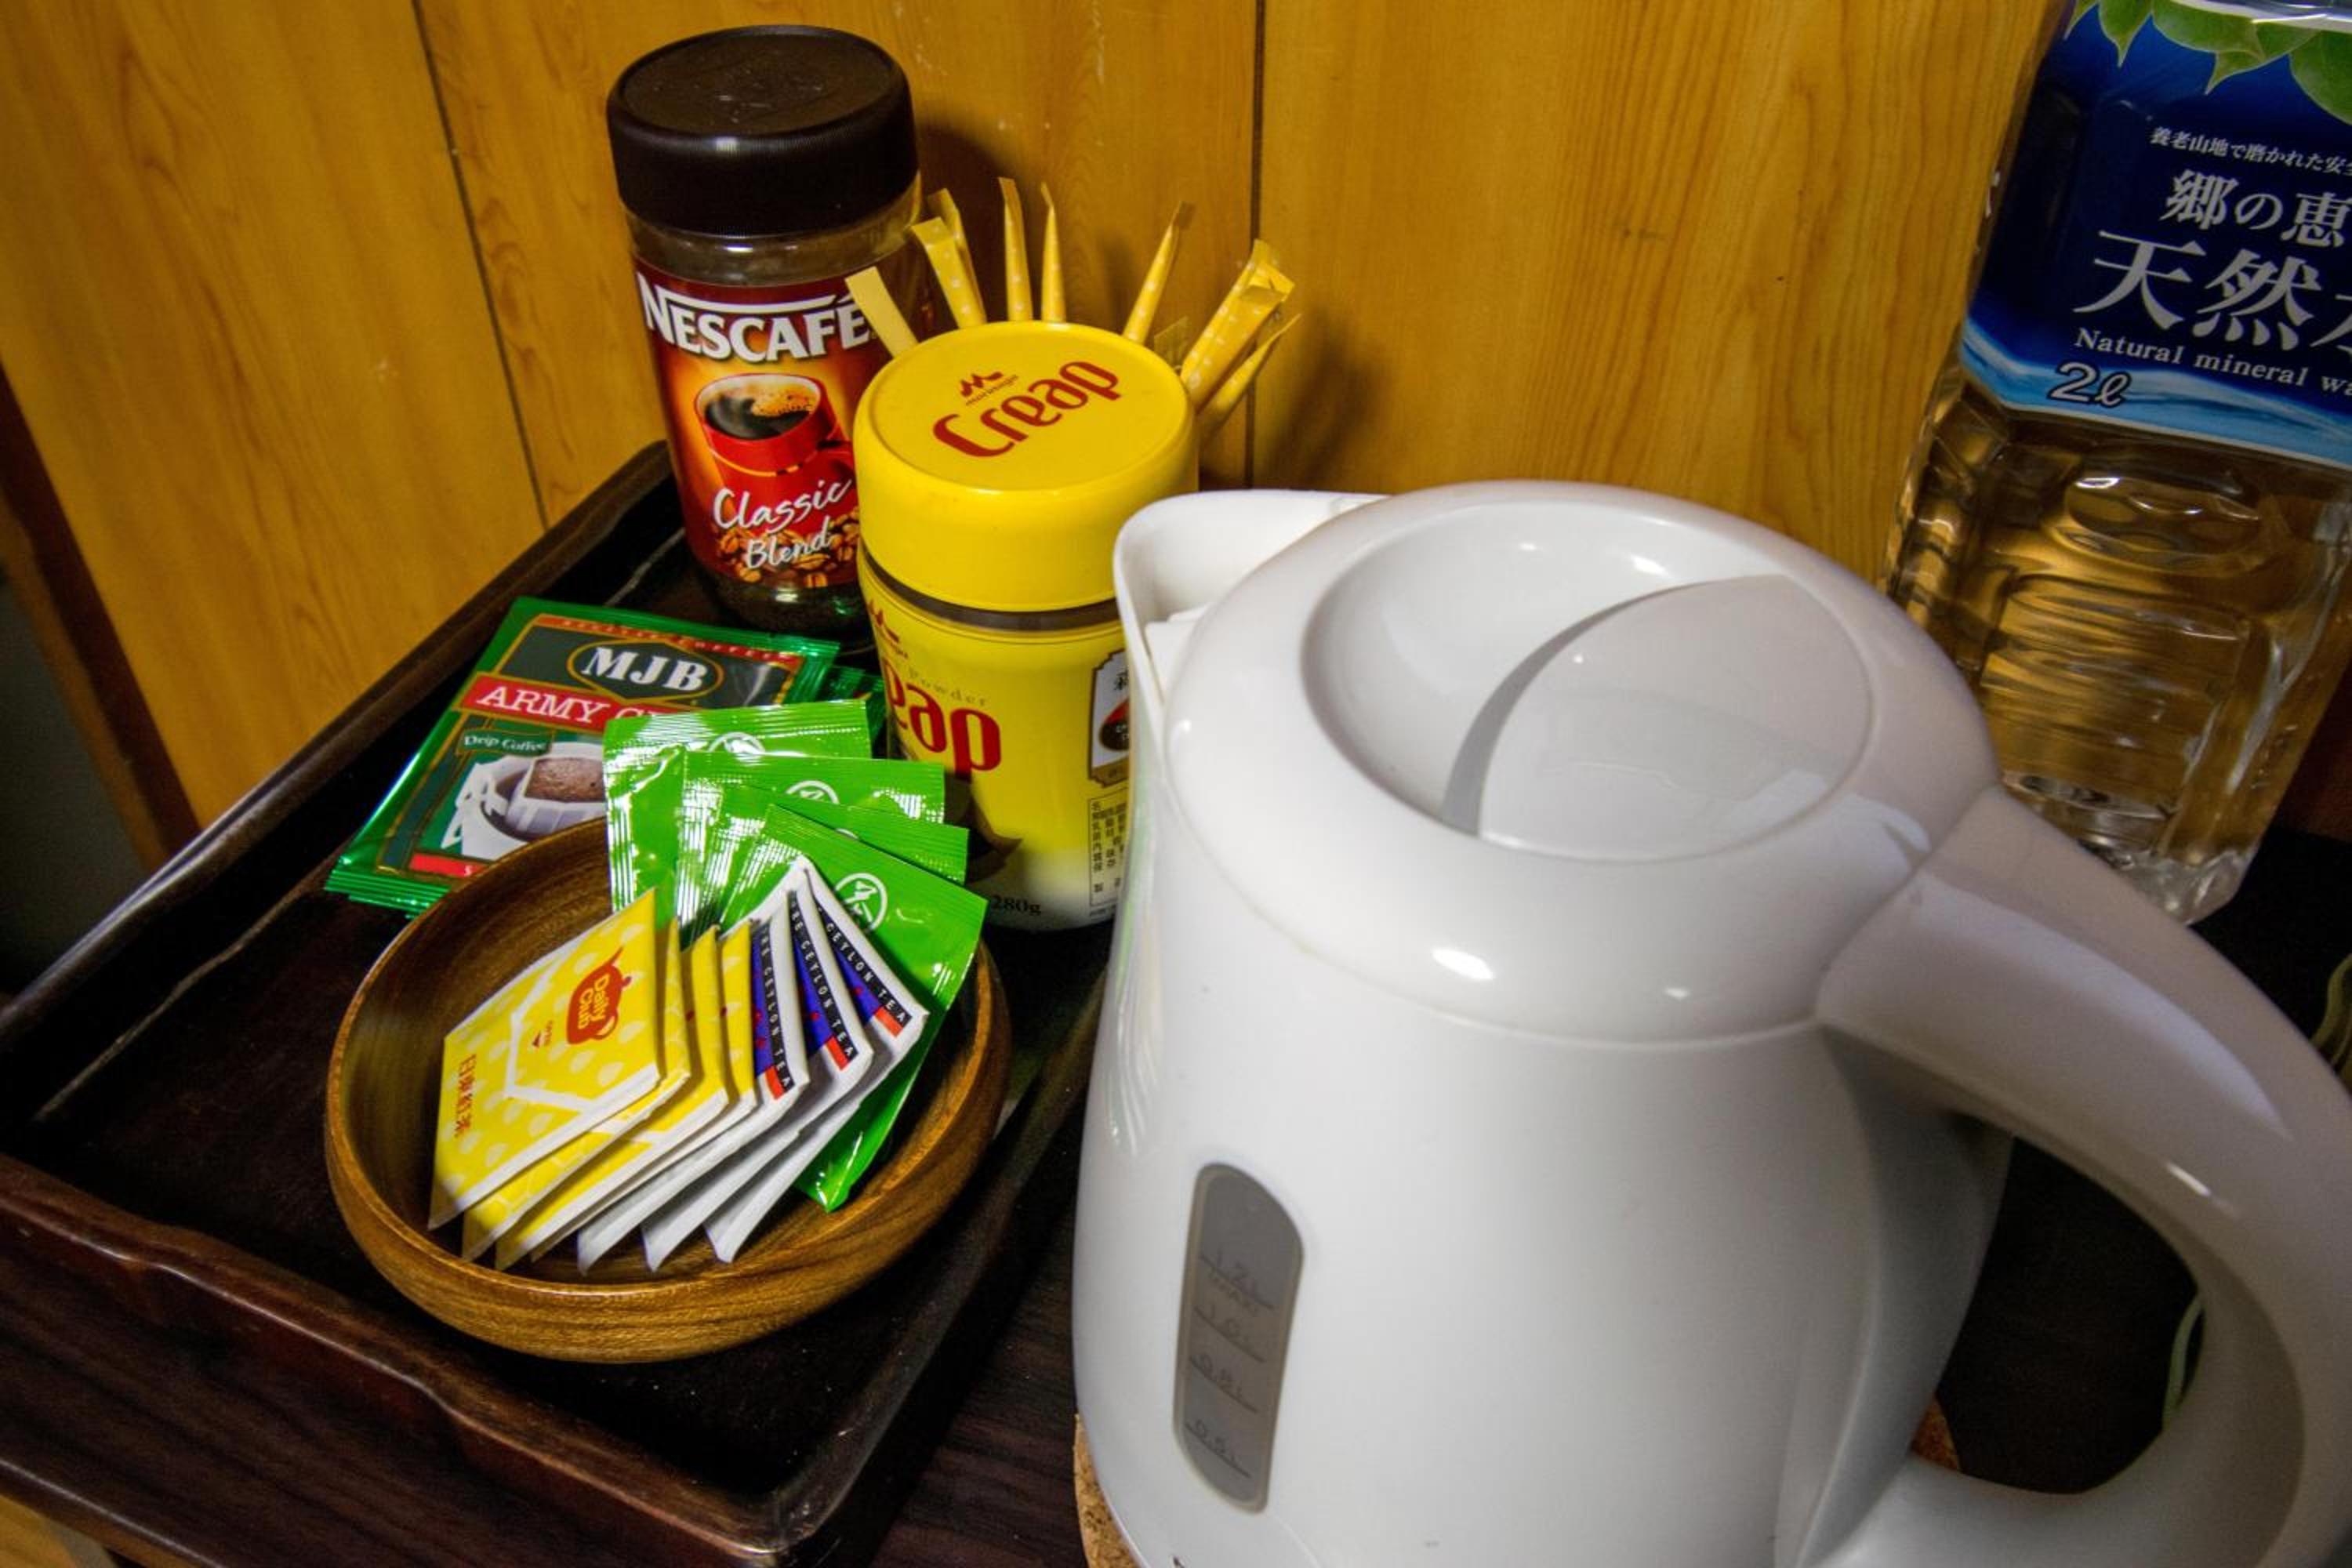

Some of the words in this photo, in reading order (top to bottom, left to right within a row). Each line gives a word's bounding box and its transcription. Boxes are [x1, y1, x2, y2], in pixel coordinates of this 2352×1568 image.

[2074, 328, 2184, 364] Natural
[2194, 353, 2309, 386] mineral
[933, 361, 1122, 458] Creap
[713, 477, 852, 532] Classic
[746, 516, 833, 569] Blend
[581, 647, 708, 691] MJB
[477, 686, 612, 724] ARMY
[463, 735, 501, 750] Drip
[503, 738, 547, 751] Coffee
[877, 989, 906, 1022] TEA
[831, 1018, 854, 1056] TEA
